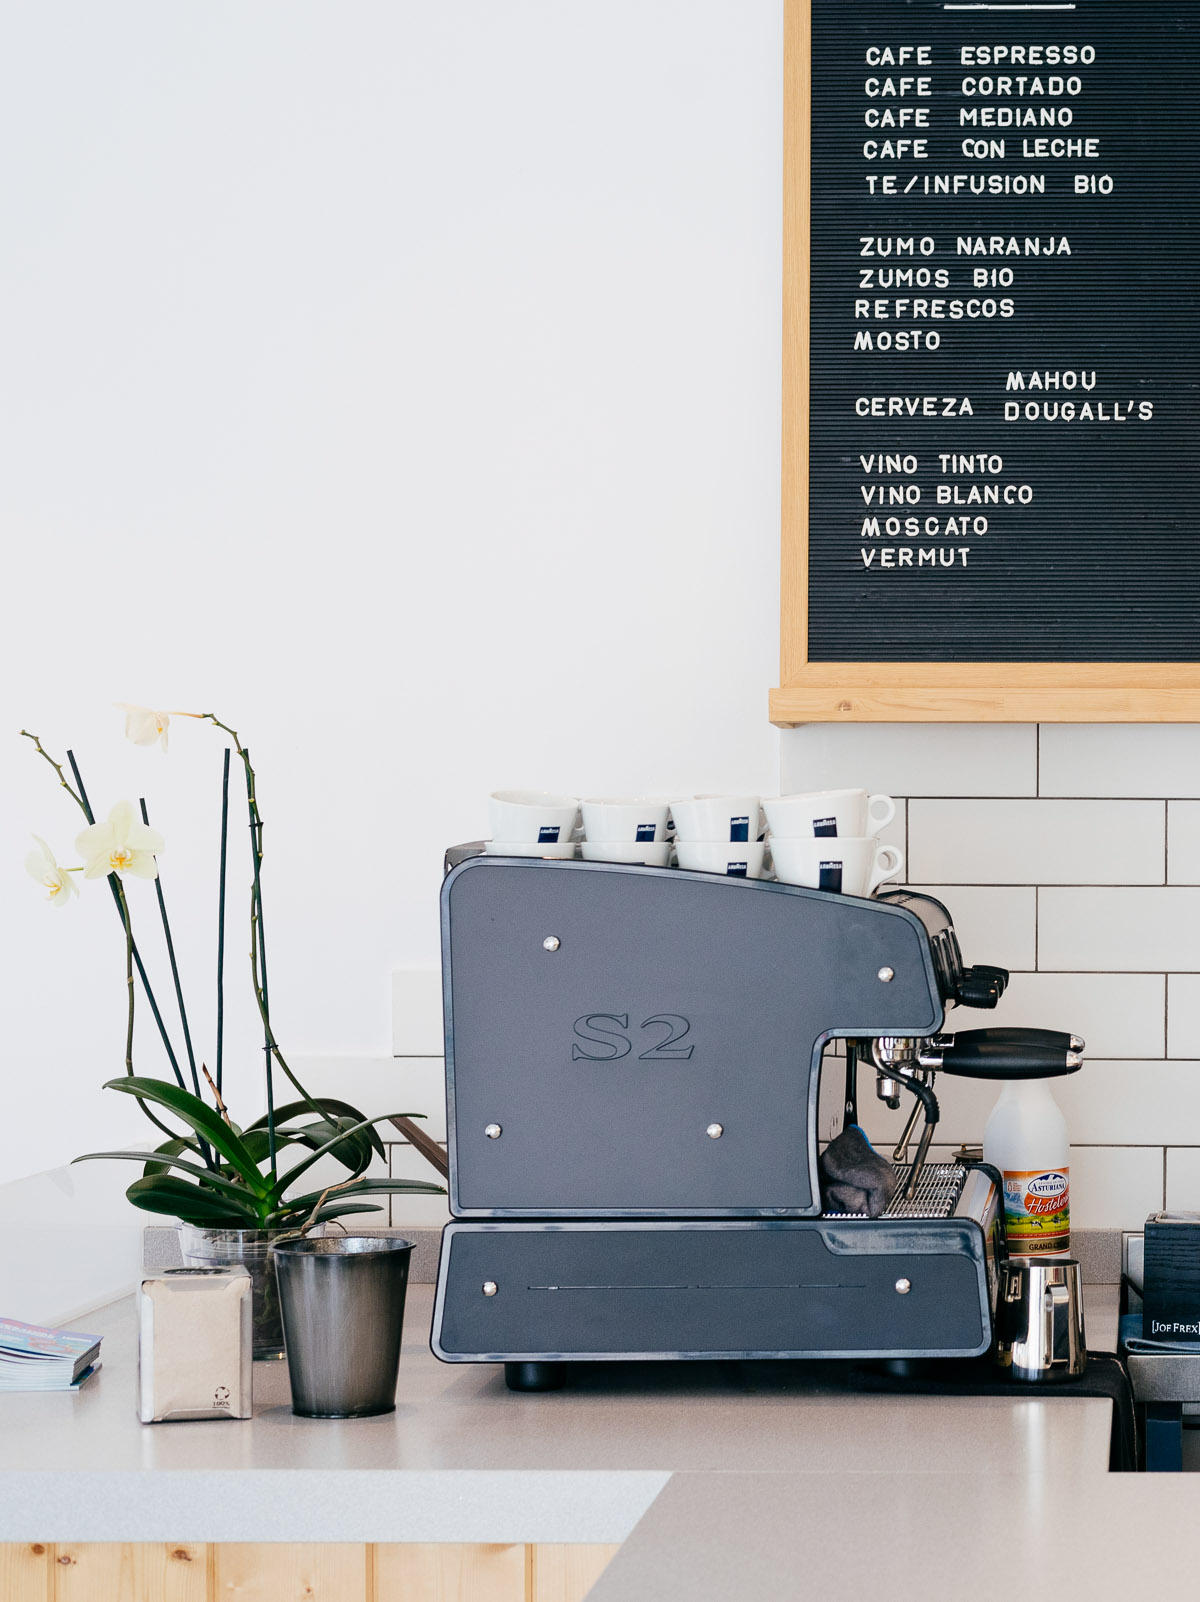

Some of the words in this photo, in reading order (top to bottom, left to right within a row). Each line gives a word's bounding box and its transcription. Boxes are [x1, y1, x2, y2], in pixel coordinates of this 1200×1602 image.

[866, 46, 932, 65] CAFE
[961, 46, 1096, 65] ESPRESSO
[865, 77, 932, 97] CAFE
[962, 77, 1082, 96] CORTADO
[865, 109, 930, 127] CAFE
[960, 108, 1073, 127] MEDIANO
[863, 139, 929, 160] CAFE
[962, 139, 1005, 158] CON
[1023, 139, 1100, 158] LECHE
[866, 175, 1045, 195] TE/INFUSION
[1075, 175, 1114, 194] BIO
[860, 237, 935, 257] ZUMO
[957, 237, 1072, 256] NARANJA
[860, 268, 950, 288] ZUMOS
[974, 268, 1014, 288] BIO
[855, 299, 1015, 319] REFRESCOS
[854, 331, 941, 350] MOSTO
[1006, 371, 1097, 391] MAHOU
[856, 397, 974, 416] CERVEZA
[1005, 401, 1154, 422] DOUGALL'S
[860, 454, 918, 474] VINO
[939, 454, 1003, 474] TINTO
[861, 485, 921, 505] VINO
[937, 485, 1033, 505] BLANCO
[861, 516, 988, 537] MOSCATO
[861, 548, 970, 568] VERMUT
[571, 1013, 695, 1061] S2
[1029, 1242, 1053, 1251] GRAND
